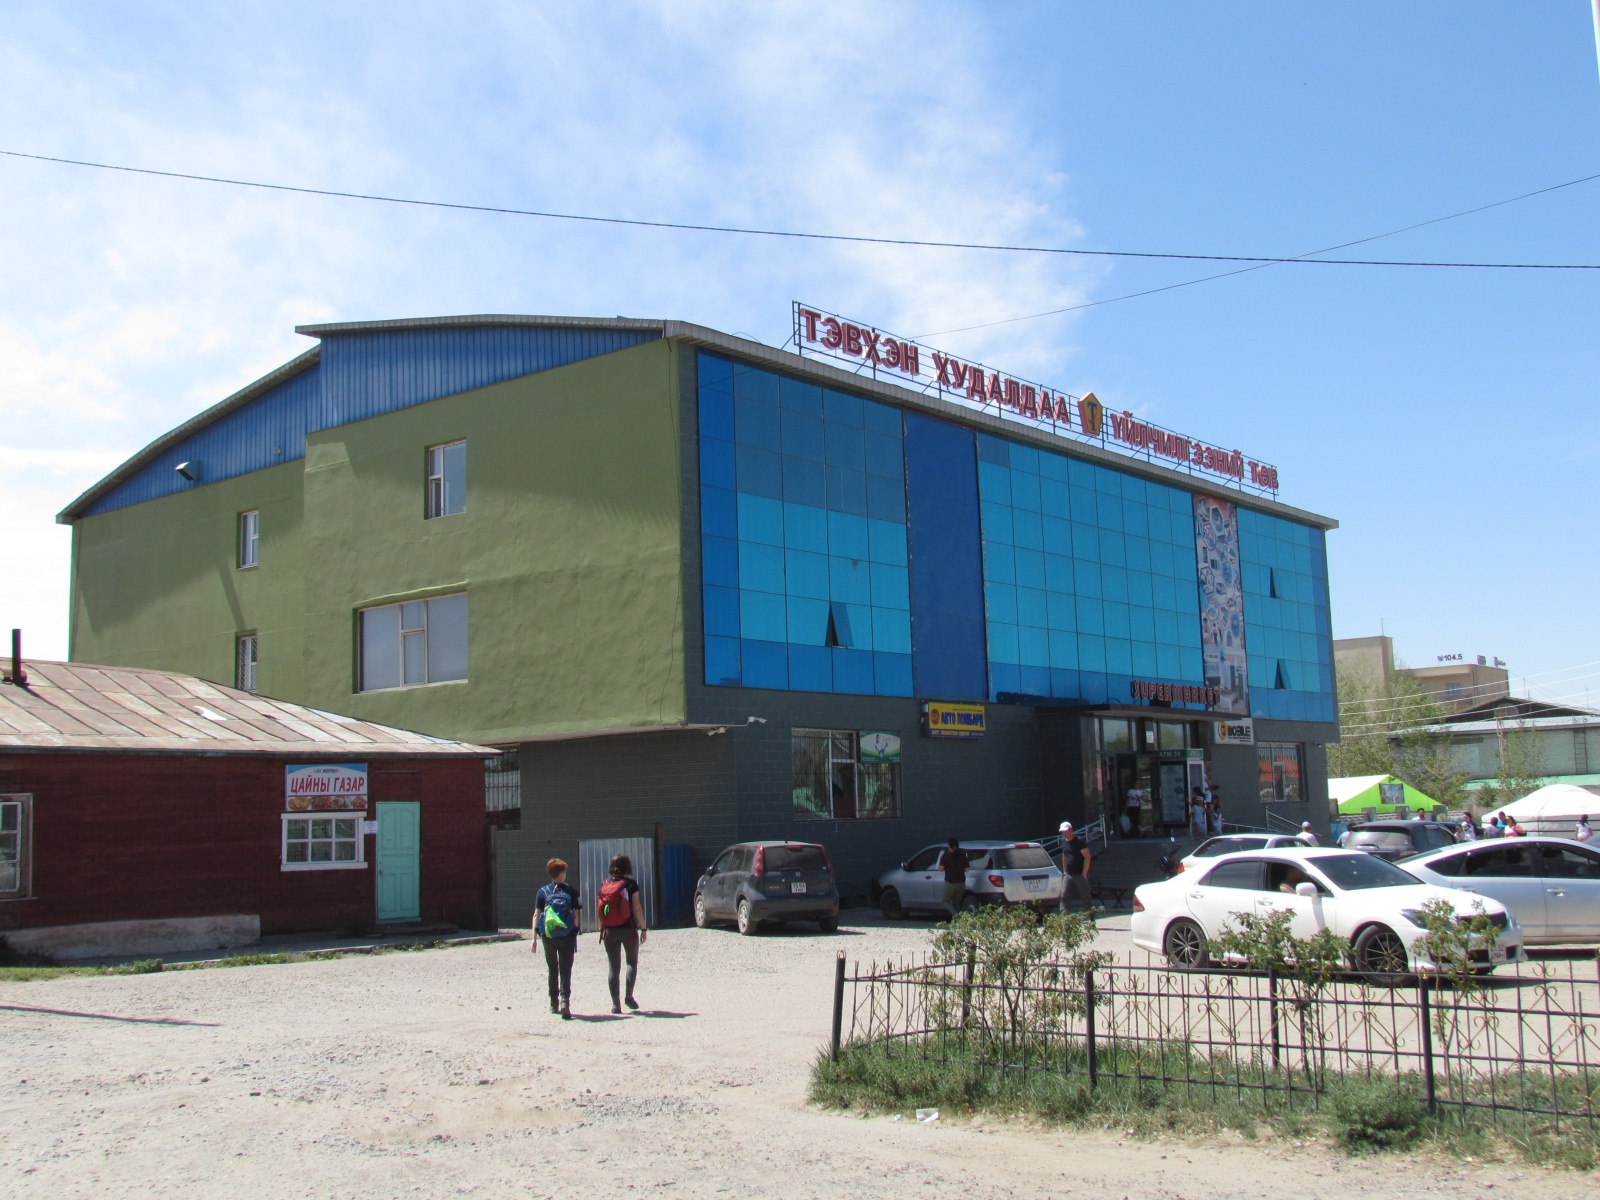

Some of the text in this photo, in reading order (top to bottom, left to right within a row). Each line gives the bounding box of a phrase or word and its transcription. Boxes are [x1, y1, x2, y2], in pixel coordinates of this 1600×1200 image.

[799, 308, 1070, 424] ТЭВХЭН ХУДАЛДАА
[1110, 410, 1280, 489] ҮЙЛЧИЛГЭЭНИЙ ТӨВ
[1133, 680, 1221, 705] SUPERMARKET
[1228, 725, 1251, 737] MOBILE
[290, 775, 365, 795] ЦАЙНЫ ГАЗАР
